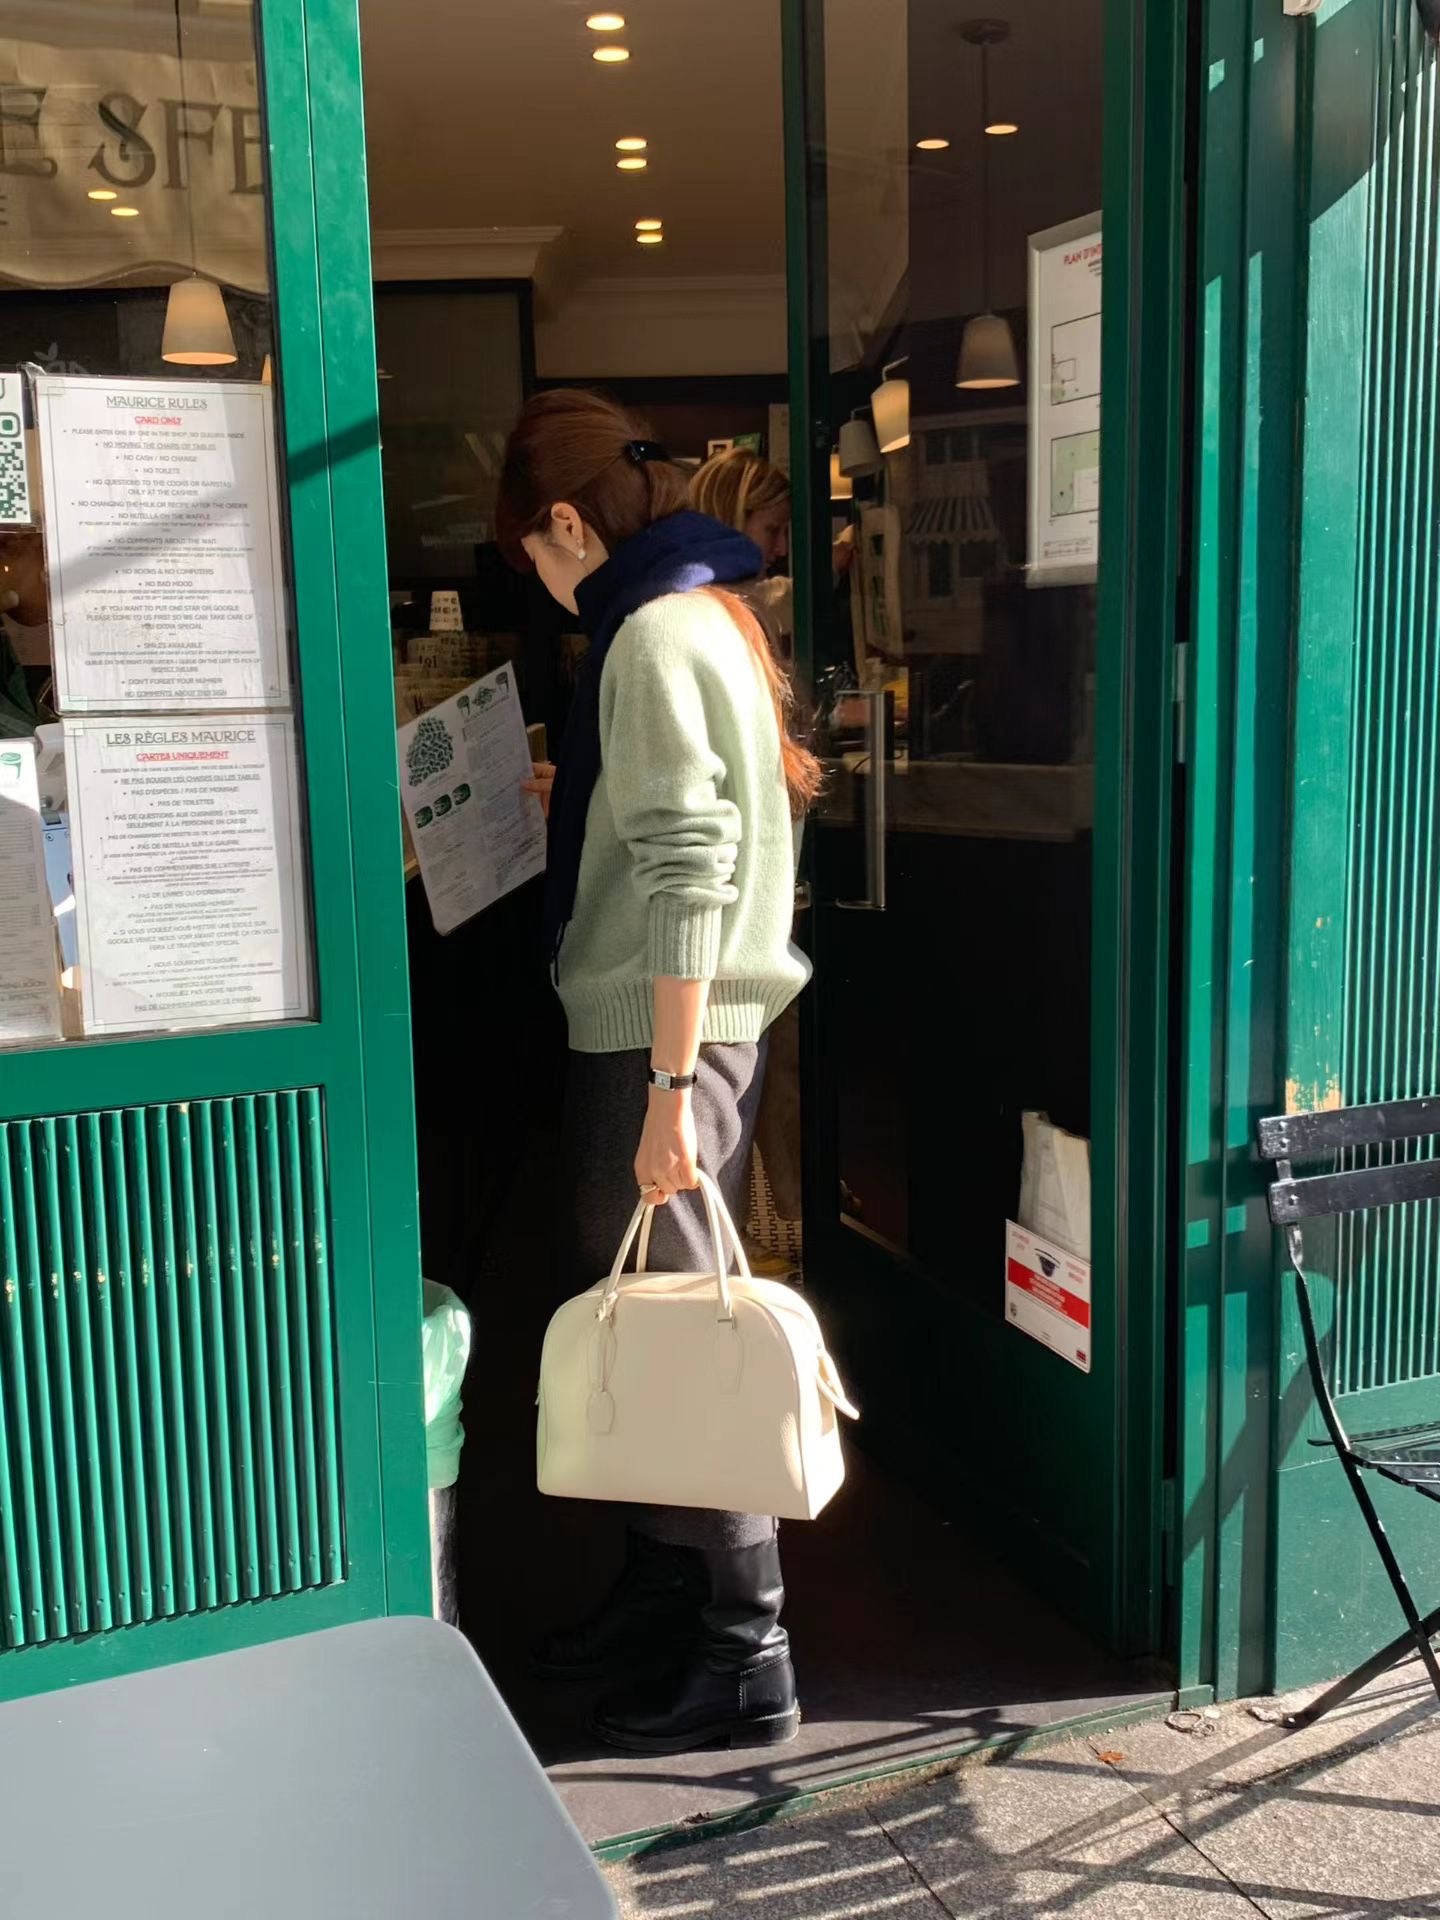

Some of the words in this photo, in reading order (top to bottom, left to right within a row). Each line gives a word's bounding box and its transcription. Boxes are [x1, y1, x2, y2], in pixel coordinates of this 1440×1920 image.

[106, 397, 165, 409] MAURICE
[168, 398, 208, 409] RULES
[135, 416, 158, 425] CARD
[161, 416, 182, 425] ONLY
[107, 733, 131, 745] LES
[135, 730, 188, 744] RÈGLES
[192, 731, 256, 743] MAURICE
[136, 752, 171, 761] CARTES
[173, 751, 229, 761] UNIQUEMENT
[159, 1001, 207, 1009] COMMENTAIRES
